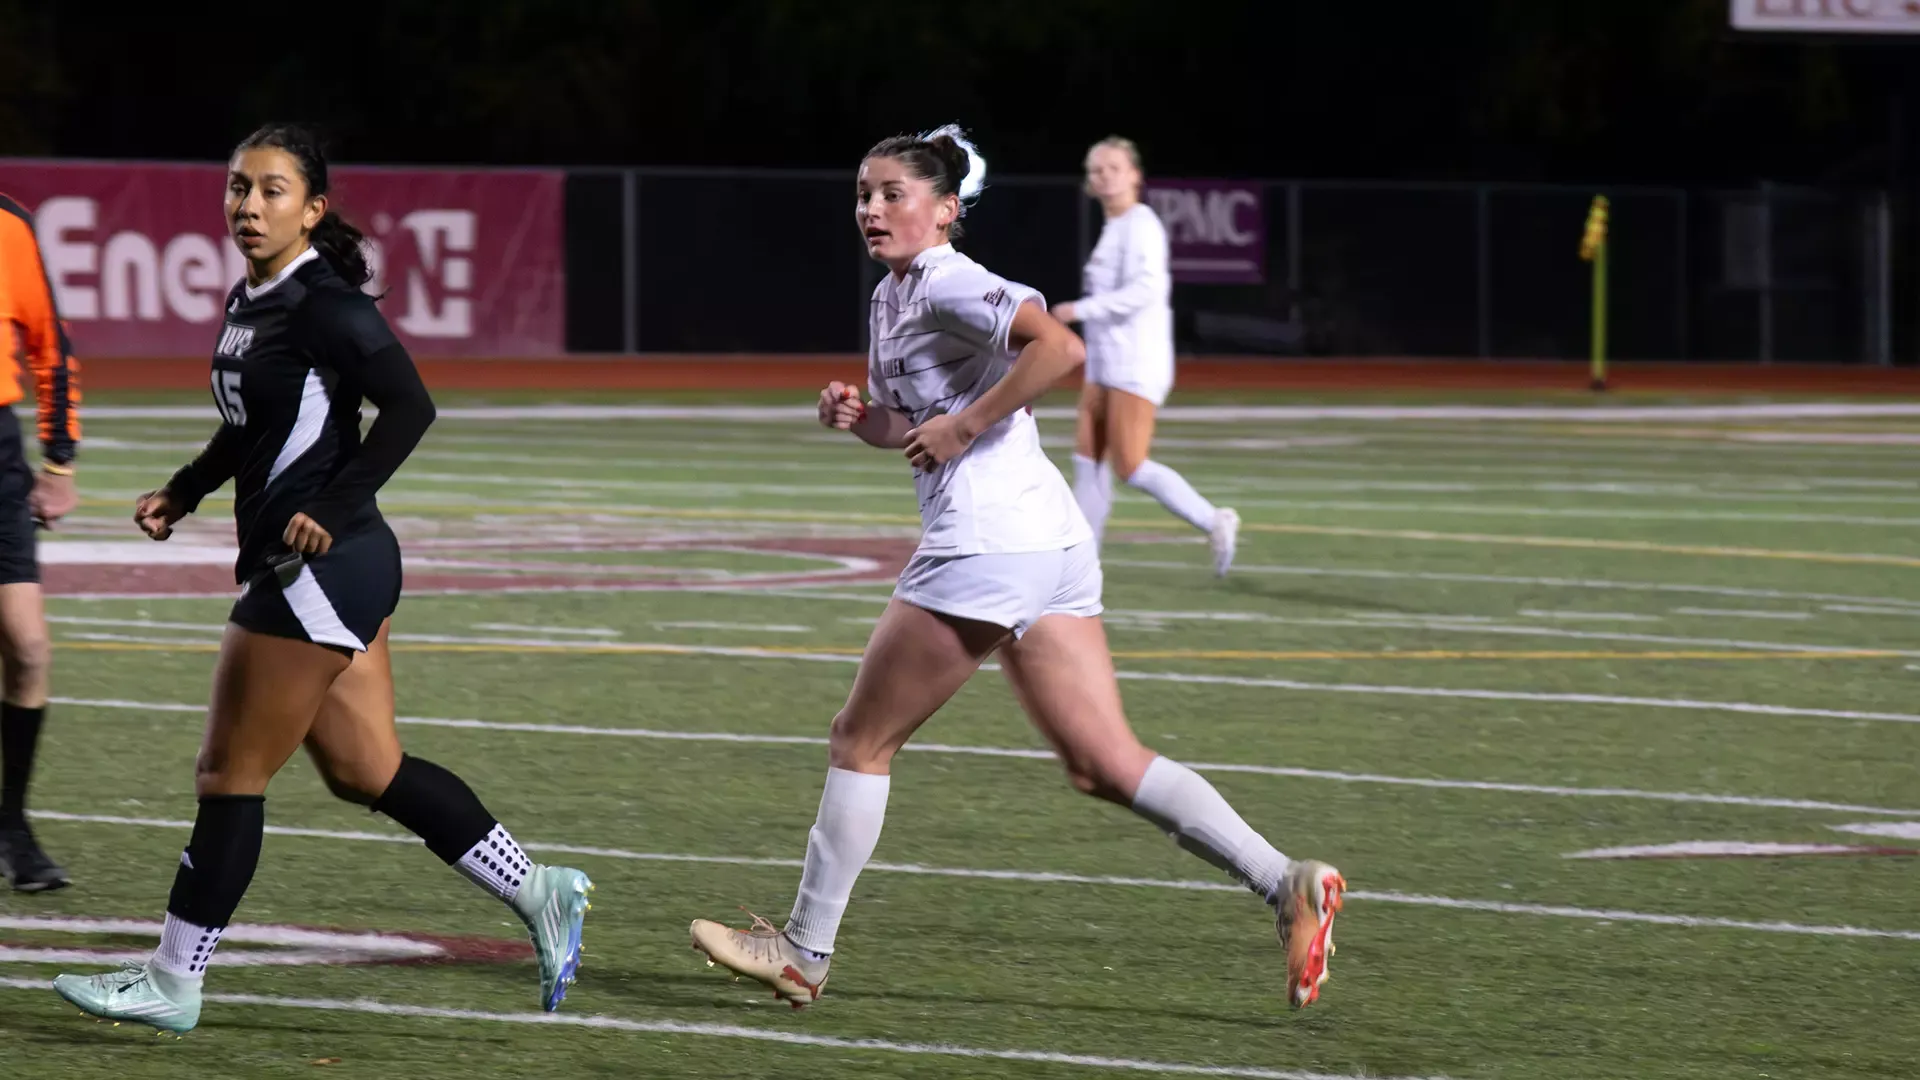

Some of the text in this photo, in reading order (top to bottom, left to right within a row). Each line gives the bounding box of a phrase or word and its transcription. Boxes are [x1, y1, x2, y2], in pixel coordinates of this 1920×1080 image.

[1146, 188, 1257, 246] PMC
[215, 322, 255, 359] IUP
[210, 369, 247, 426] 15
